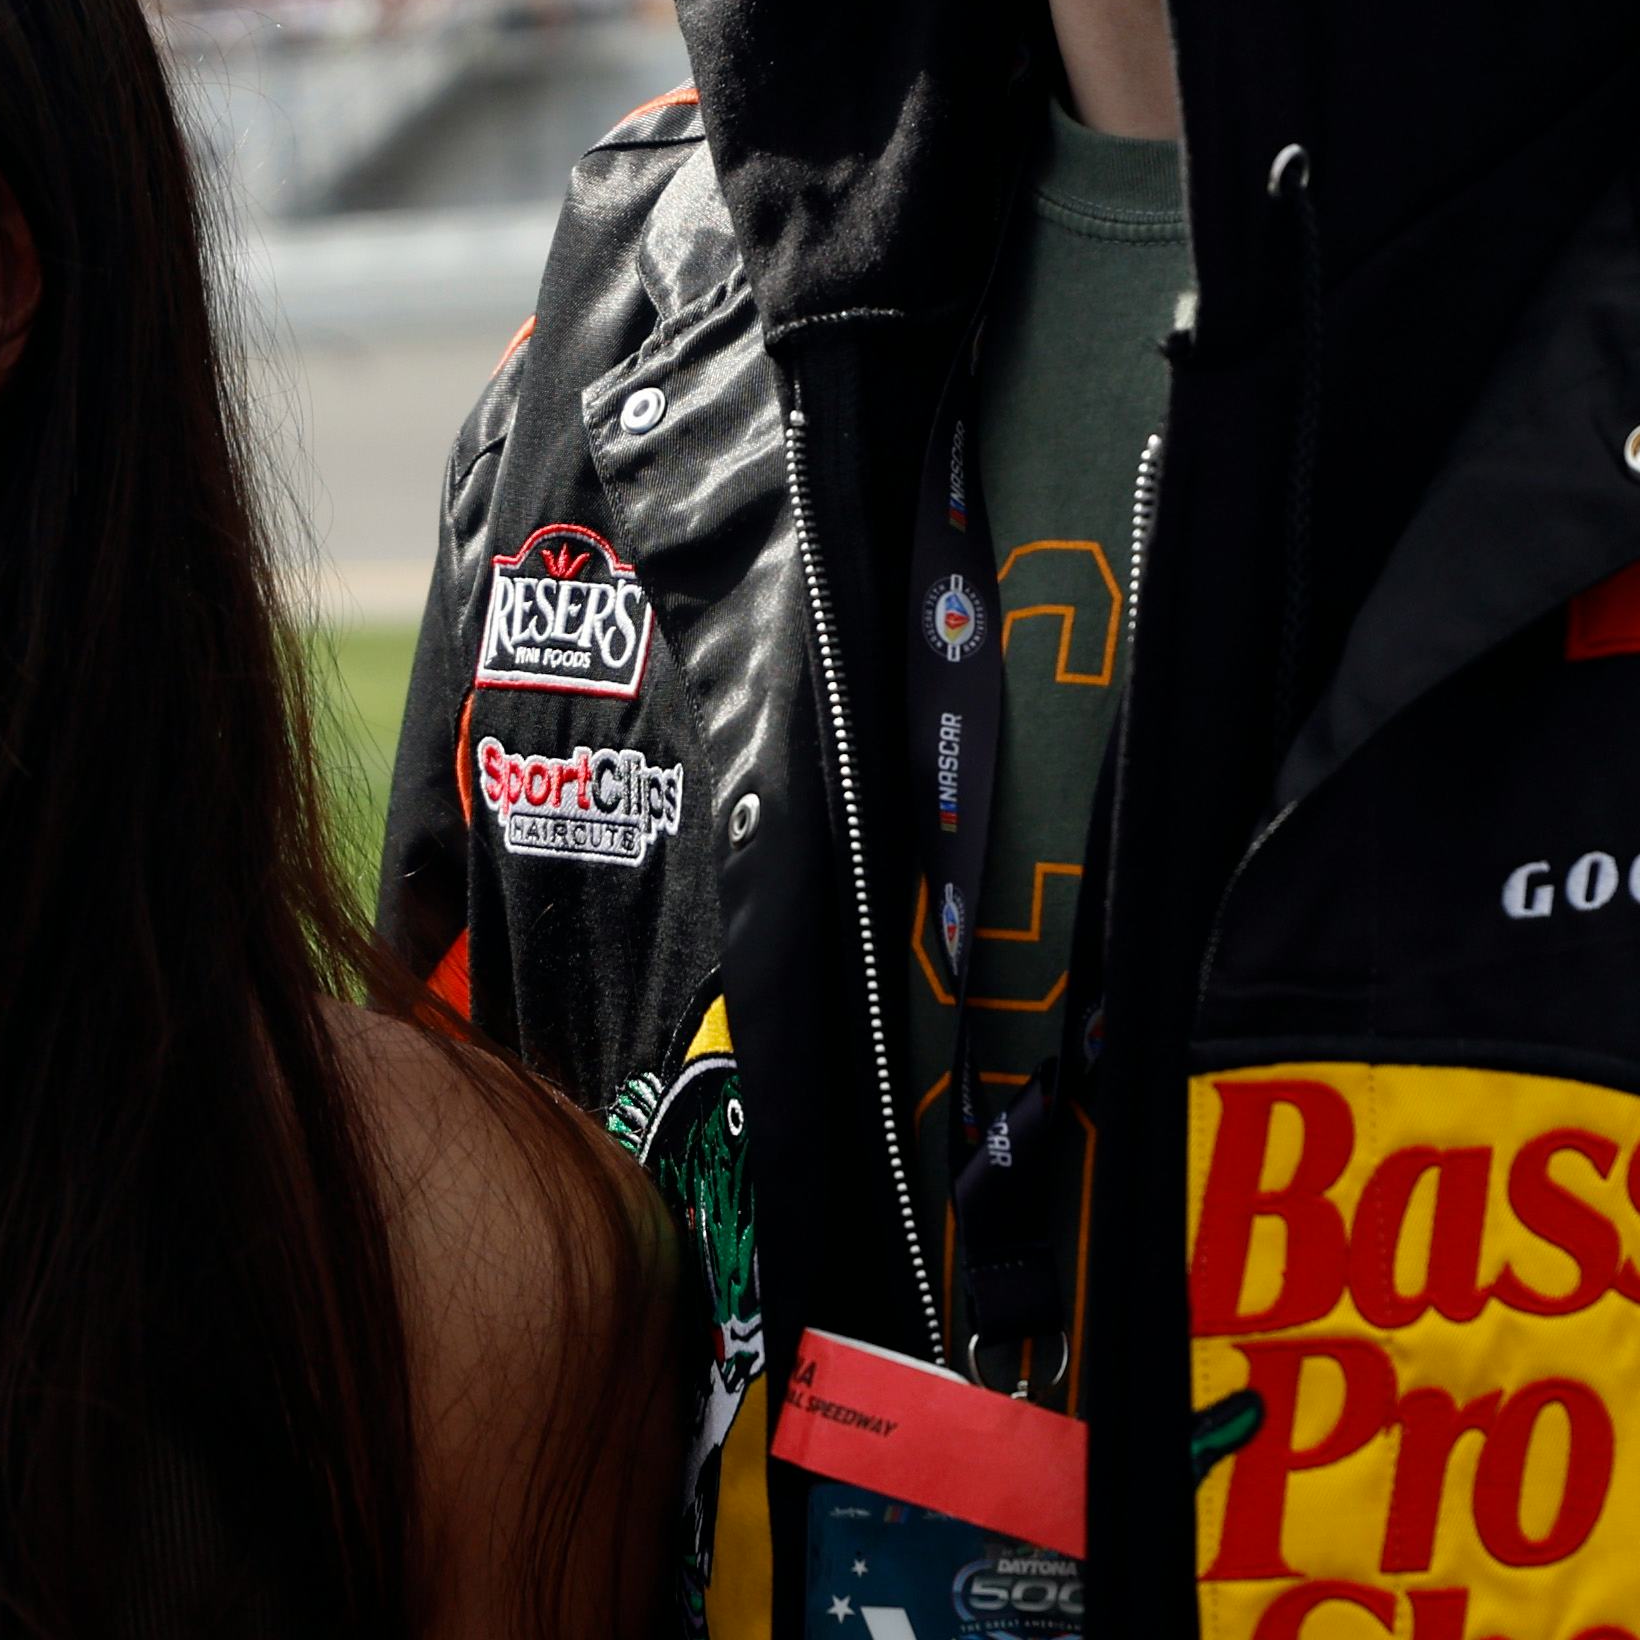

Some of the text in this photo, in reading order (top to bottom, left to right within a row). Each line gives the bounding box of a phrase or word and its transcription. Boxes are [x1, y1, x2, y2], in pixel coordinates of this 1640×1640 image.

[949, 418, 966, 507] NASCAR
[485, 575, 644, 669] RESER'S
[541, 647, 592, 669] FOODS
[481, 742, 681, 833] SportClips
[938, 712, 963, 802] NASCAR
[510, 814, 636, 854] HAIRCUTS
[806, 1396, 898, 1438] SPEEDWAY
[1198, 1336, 1616, 1582] Pro
[997, 1558, 1078, 1576] DAYTONA
